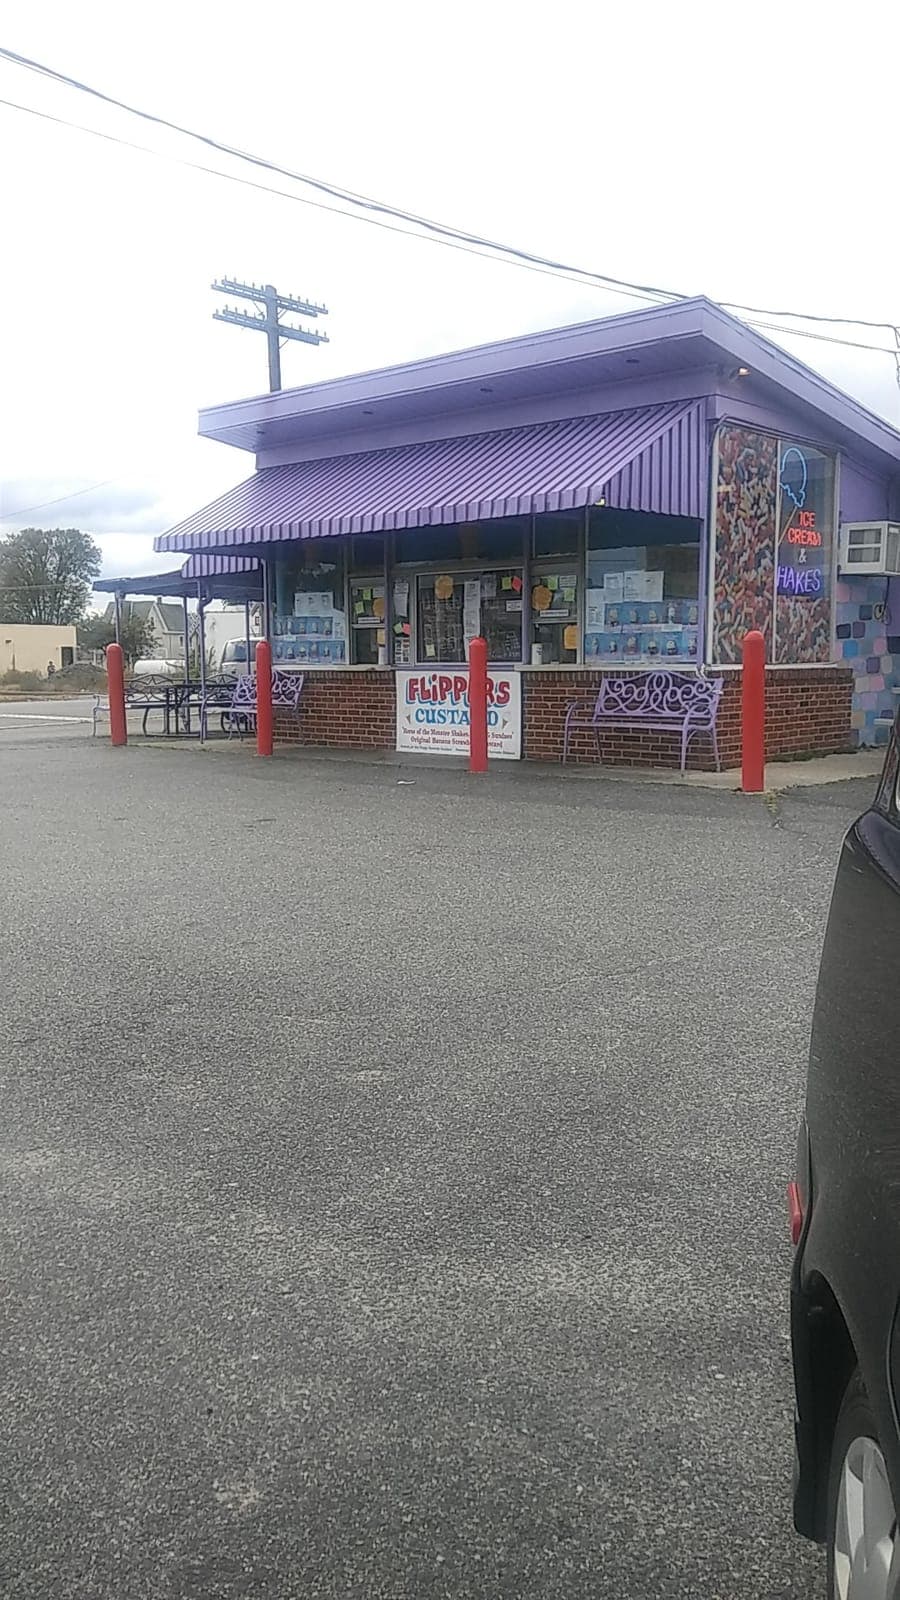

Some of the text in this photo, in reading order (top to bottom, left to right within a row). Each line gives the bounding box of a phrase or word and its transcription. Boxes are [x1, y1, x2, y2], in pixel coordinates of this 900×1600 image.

[799, 511, 816, 527] ICE
[788, 528, 822, 546] CREAM
[798, 548, 808, 563] &
[776, 566, 821, 594] HAKES
[407, 674, 510, 706] FLiPPRS
[415, 708, 499, 726] CUSTAD
